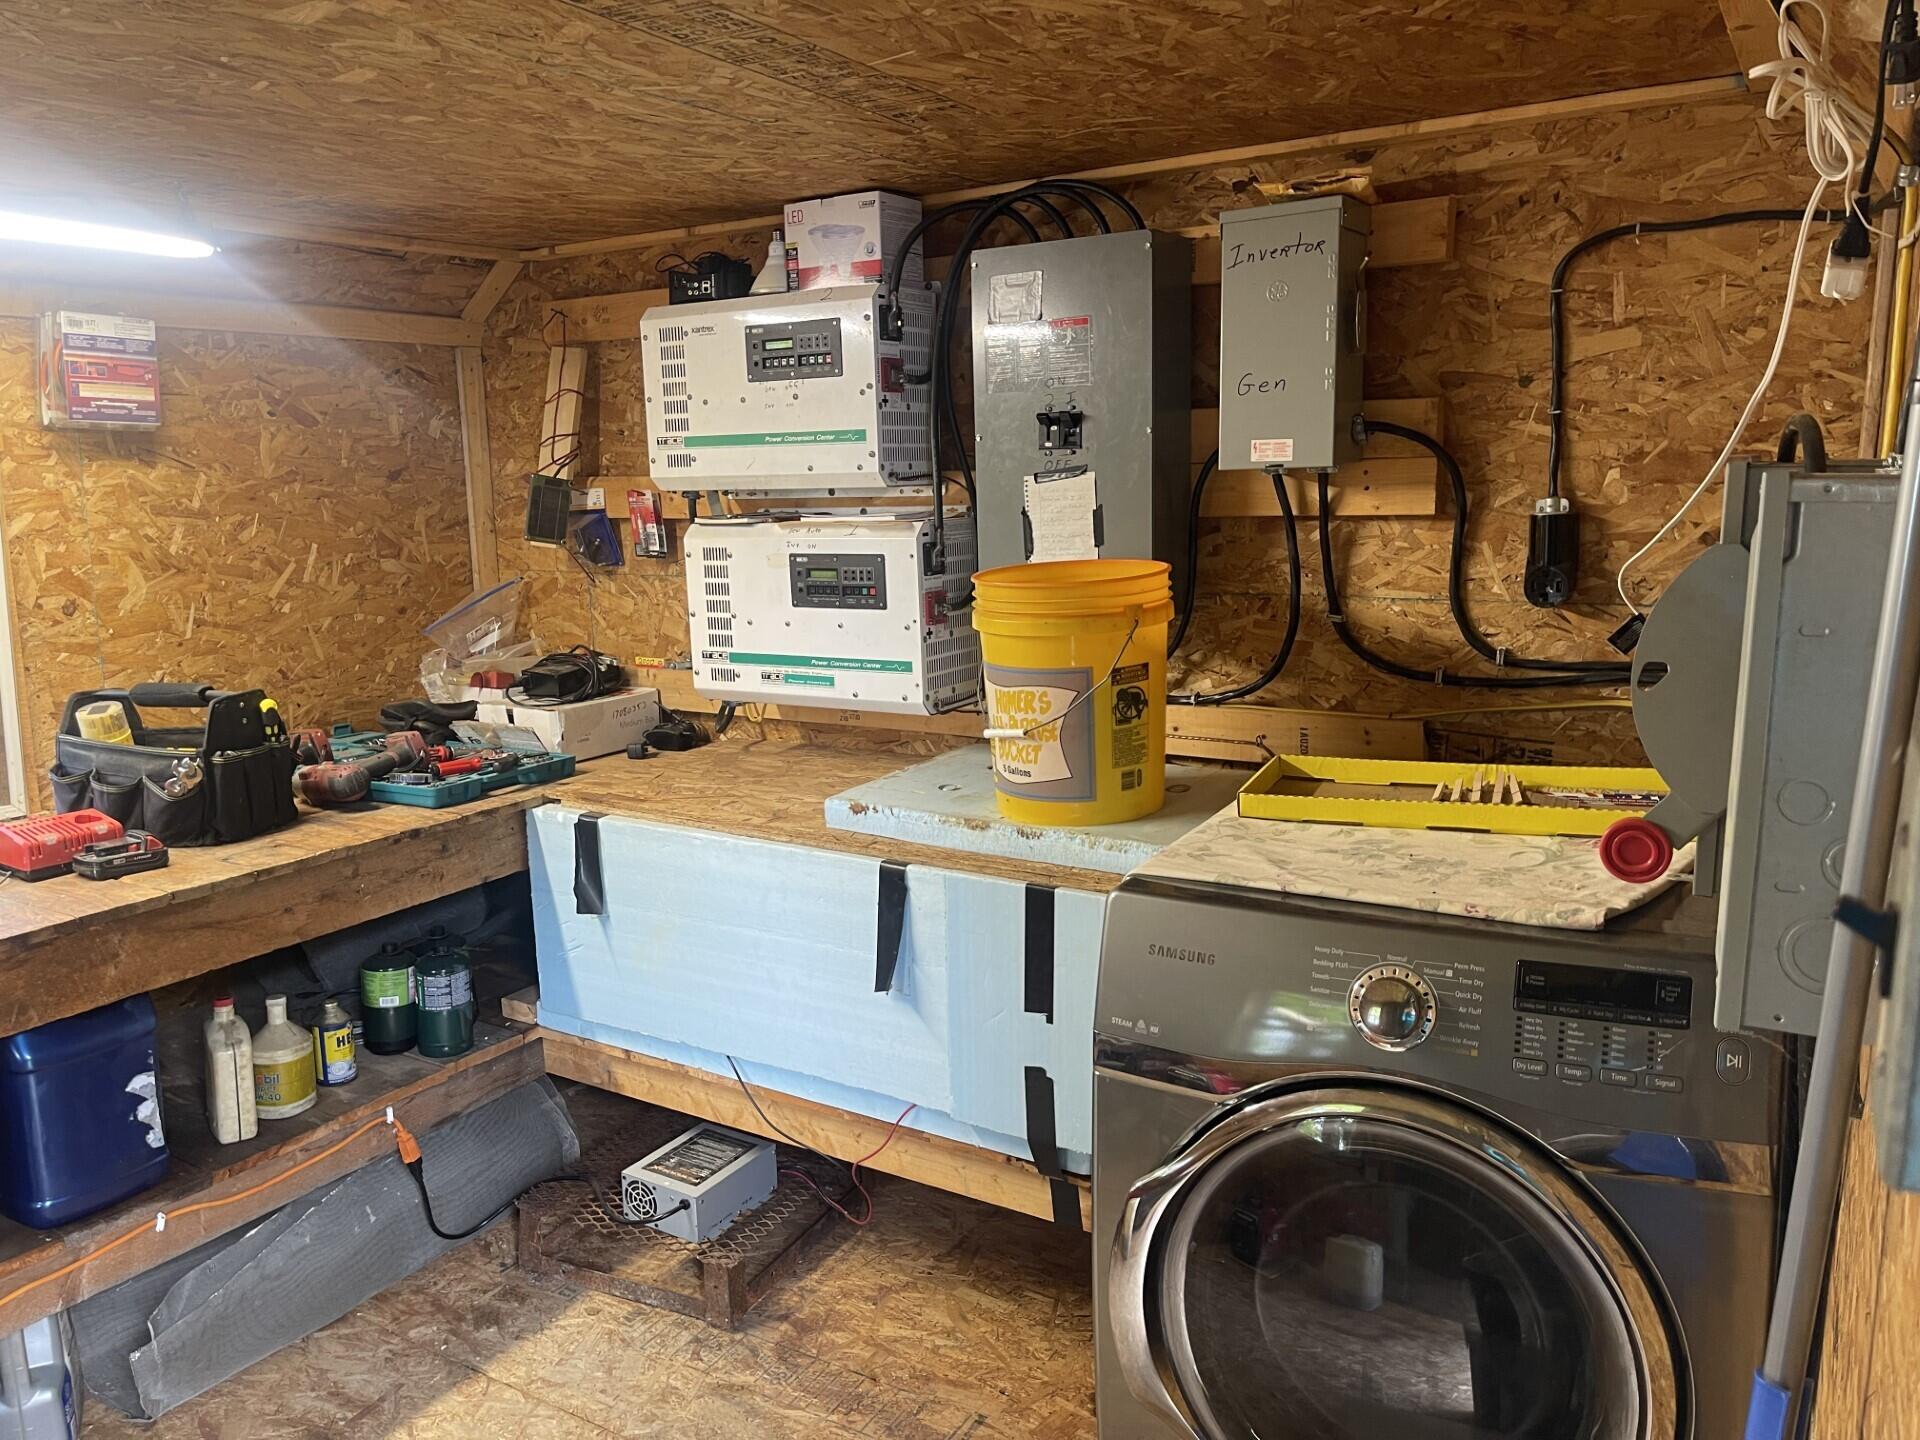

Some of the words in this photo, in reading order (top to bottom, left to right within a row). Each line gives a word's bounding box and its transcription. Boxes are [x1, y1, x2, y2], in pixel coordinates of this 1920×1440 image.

[786, 209, 804, 225] LED
[819, 287, 832, 301] 2
[1237, 372, 1287, 397] Gen
[764, 436, 783, 444] Power
[784, 434, 815, 442] Conversion
[816, 433, 836, 441] Center
[1044, 458, 1072, 471] OFF
[811, 659, 829, 667] Power
[830, 660, 861, 669] Conversion
[862, 661, 882, 669] Center
[994, 687, 1053, 715] HOMER'S
[1007, 765, 1032, 778] Gallons
[1148, 943, 1216, 967] SAMSUNG
[1335, 961, 1349, 970] PLUS
[1423, 966, 1446, 977] Manual
[1473, 978, 1485, 988] Dry
[1454, 990, 1472, 1000] Quick
[1472, 992, 1483, 1002] Dry
[1458, 1006, 1467, 1015] Air
[1468, 1007, 1482, 1016] Fluff
[1111, 1016, 1133, 1028] STEAM
[1458, 1022, 1481, 1032] Refresh
[1516, 1061, 1527, 1071] Dry
[1527, 1062, 1544, 1072] Level
[1564, 1066, 1583, 1077] Temp
[1611, 1072, 1628, 1082] Time
[1655, 1078, 1677, 1089] Signal
